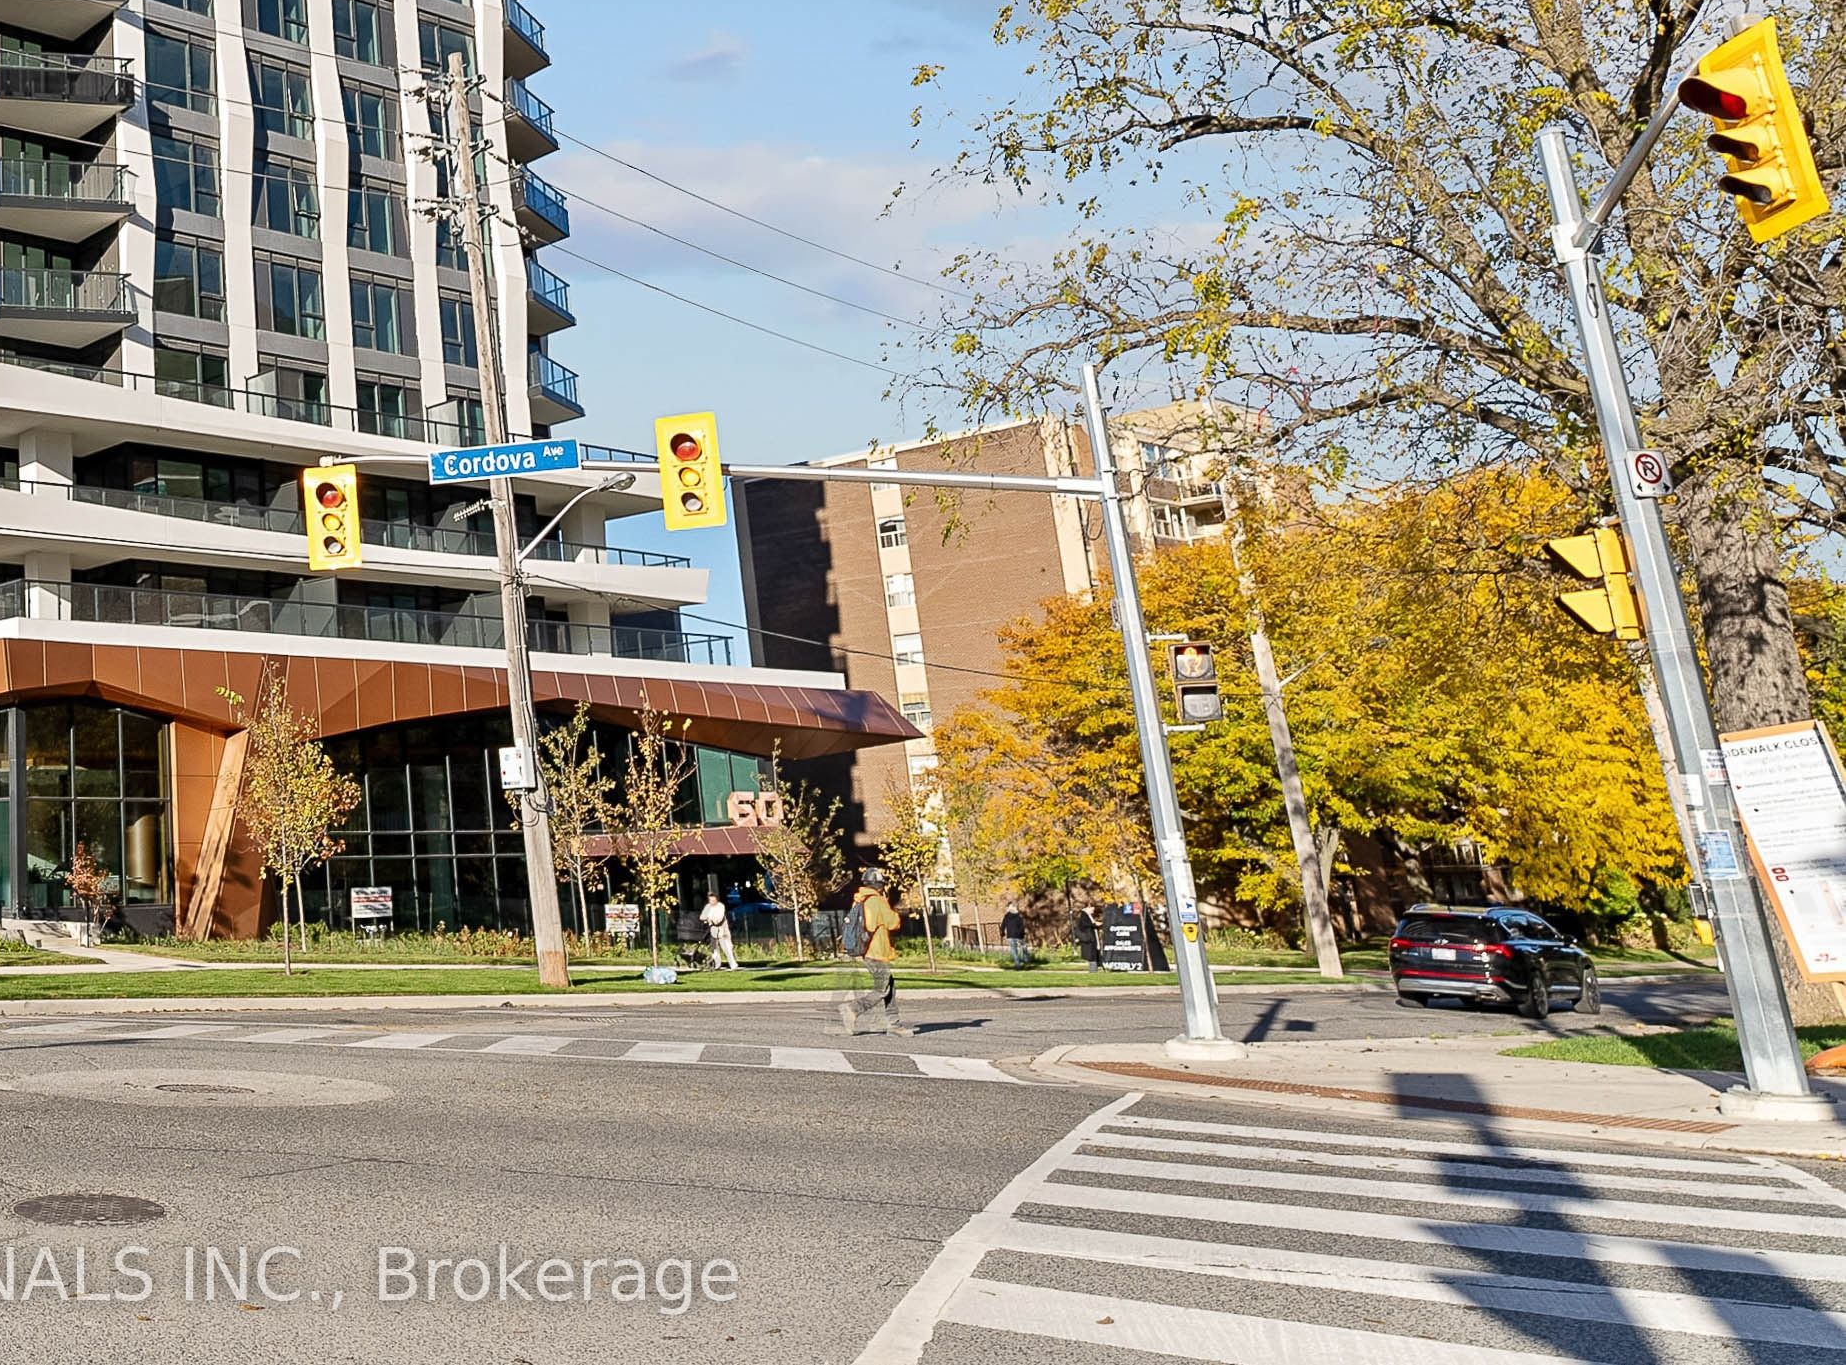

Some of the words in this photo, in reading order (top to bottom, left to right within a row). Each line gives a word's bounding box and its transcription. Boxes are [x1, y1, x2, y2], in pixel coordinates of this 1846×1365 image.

[444, 451, 536, 476] Cordova
[543, 445, 564, 458] Ave
[1722, 743, 1782, 759] SIDEWALK
